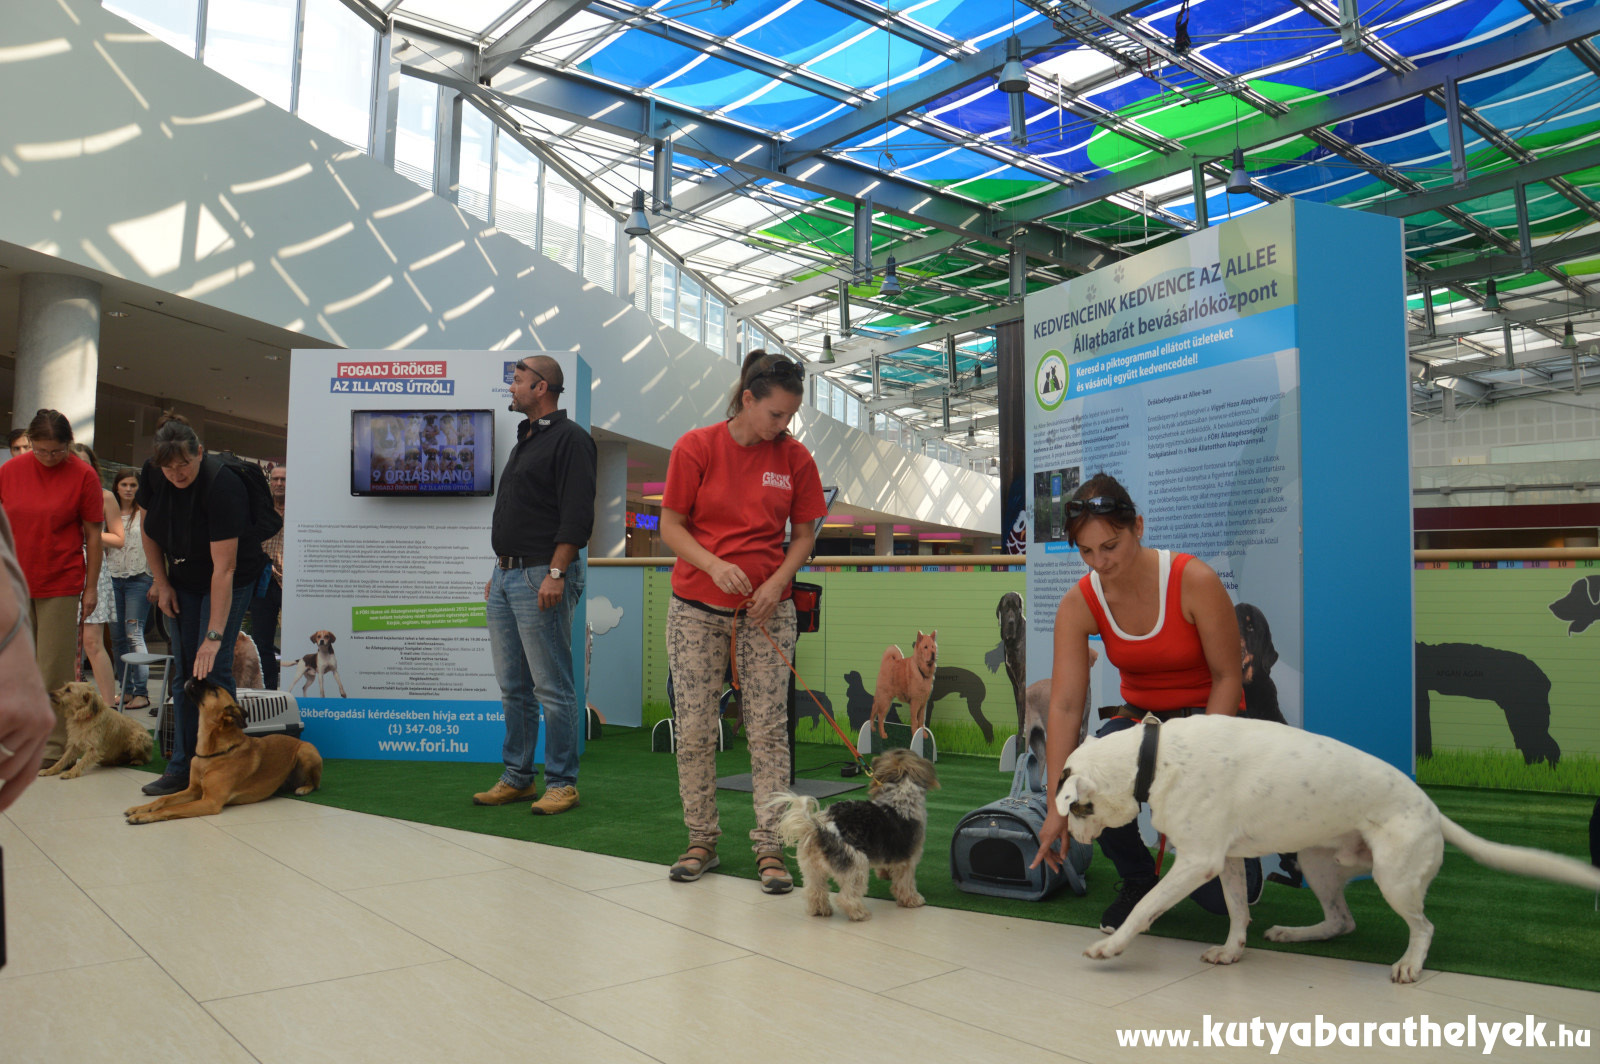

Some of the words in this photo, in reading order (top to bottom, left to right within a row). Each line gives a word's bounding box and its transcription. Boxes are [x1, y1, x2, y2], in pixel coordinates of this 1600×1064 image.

[1034, 297, 1116, 339] KEDVENCEINK
[1120, 271, 1195, 312] KEDVENCE
[1200, 262, 1221, 286] AZ
[1226, 244, 1277, 278] ALLEE
[1074, 321, 1134, 354] Állatbarát
[1138, 279, 1278, 335] bevásárlóközpont
[1076, 362, 1099, 377] Keresd
[1106, 346, 1159, 371] piktogrammal
[1160, 339, 1191, 355] ellátott
[1193, 328, 1234, 347] üzleteket
[340, 365, 388, 376] FOGADJ
[392, 362, 443, 375] ÖRÖKBE
[1076, 382, 1084, 392] és
[1085, 374, 1112, 390] vásárolj
[1113, 369, 1138, 384] együtt
[1139, 353, 1198, 376] kedvenceddel!
[333, 381, 349, 392] AZ
[352, 381, 403, 392] ILLATOS
[407, 380, 451, 393] ÚTRÓL!
[372, 470, 381, 481] 9
[1217, 568, 1236, 578] ársad,
[300, 707, 366, 721] ökbefogadási
[368, 709, 430, 720] kérdésekben
[433, 710, 457, 722] hívja
[459, 712, 474, 721] ezt
[477, 713, 484, 721] a
[486, 711, 505, 721] tele
[388, 723, 402, 735] (1)
[405, 724, 460, 735] 347-08-30
[378, 738, 469, 753] www.fori.hu
